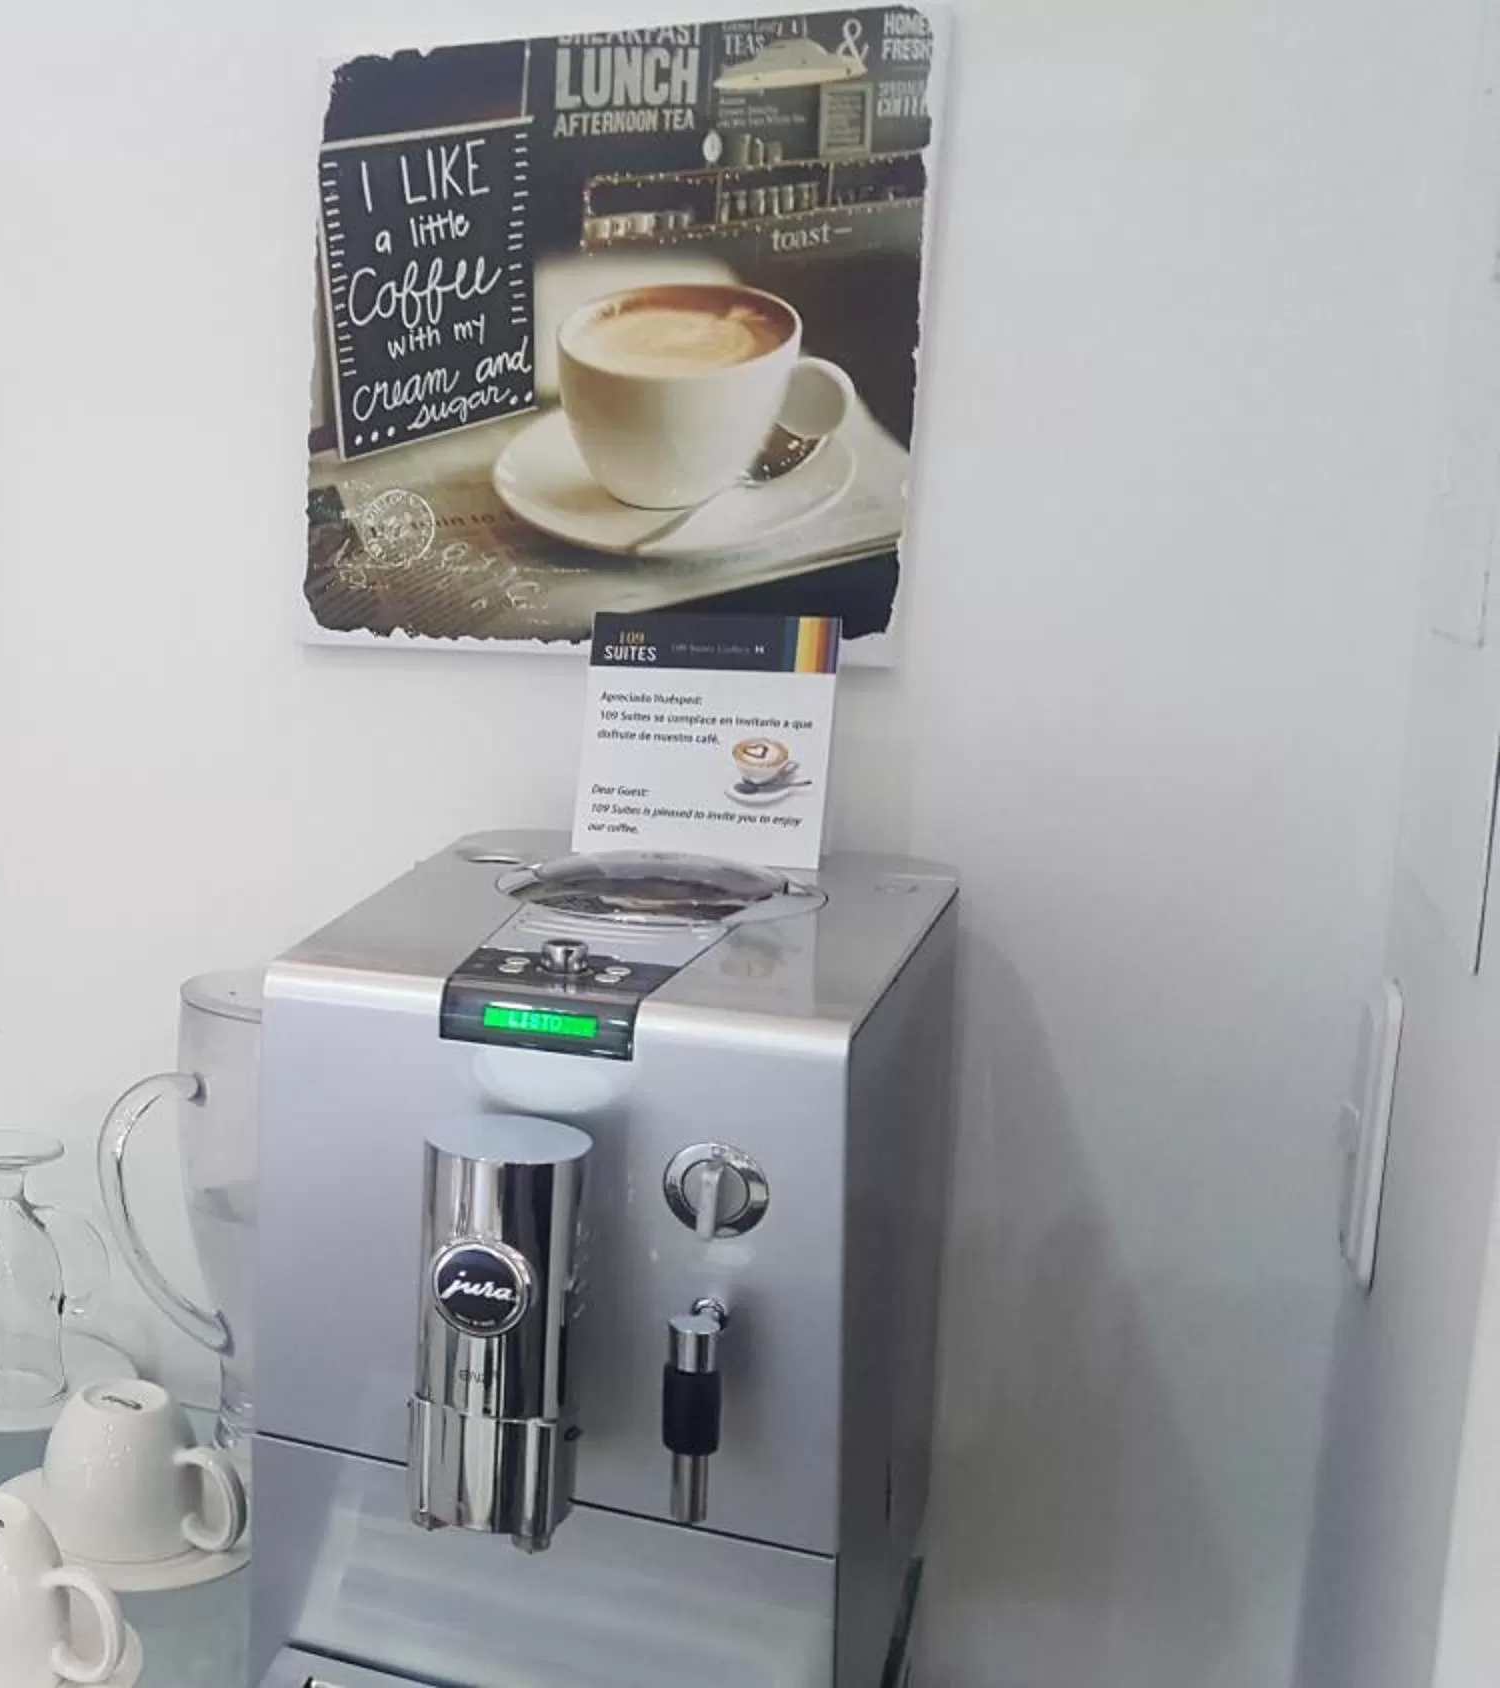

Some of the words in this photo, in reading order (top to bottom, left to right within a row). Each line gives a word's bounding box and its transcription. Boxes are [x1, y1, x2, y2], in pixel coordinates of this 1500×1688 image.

[554, 47, 700, 109] LUNCH
[553, 110, 658, 139] AFTERNOON
[663, 108, 694, 132] TEA
[360, 160, 373, 213] I
[400, 138, 491, 206] LIKE
[375, 229, 392, 255] a
[409, 209, 470, 248] little
[349, 255, 503, 329] Coffee
[387, 325, 441, 360] with
[453, 312, 485, 345] my
[475, 335, 533, 384] and
[603, 644, 658, 662] SUITES
[601, 710, 618, 720] 109
[668, 714, 717, 726] complace
[719, 716, 733, 726] en
[792, 720, 813, 731] que
[638, 730, 651, 740] de
[591, 783, 615, 795] Dear
[651, 806, 694, 819] pleased
[707, 811, 736, 821] invite
[736, 814, 758, 825] you
[772, 815, 803, 829] enjoy
[441, 1269, 514, 1301] jura
